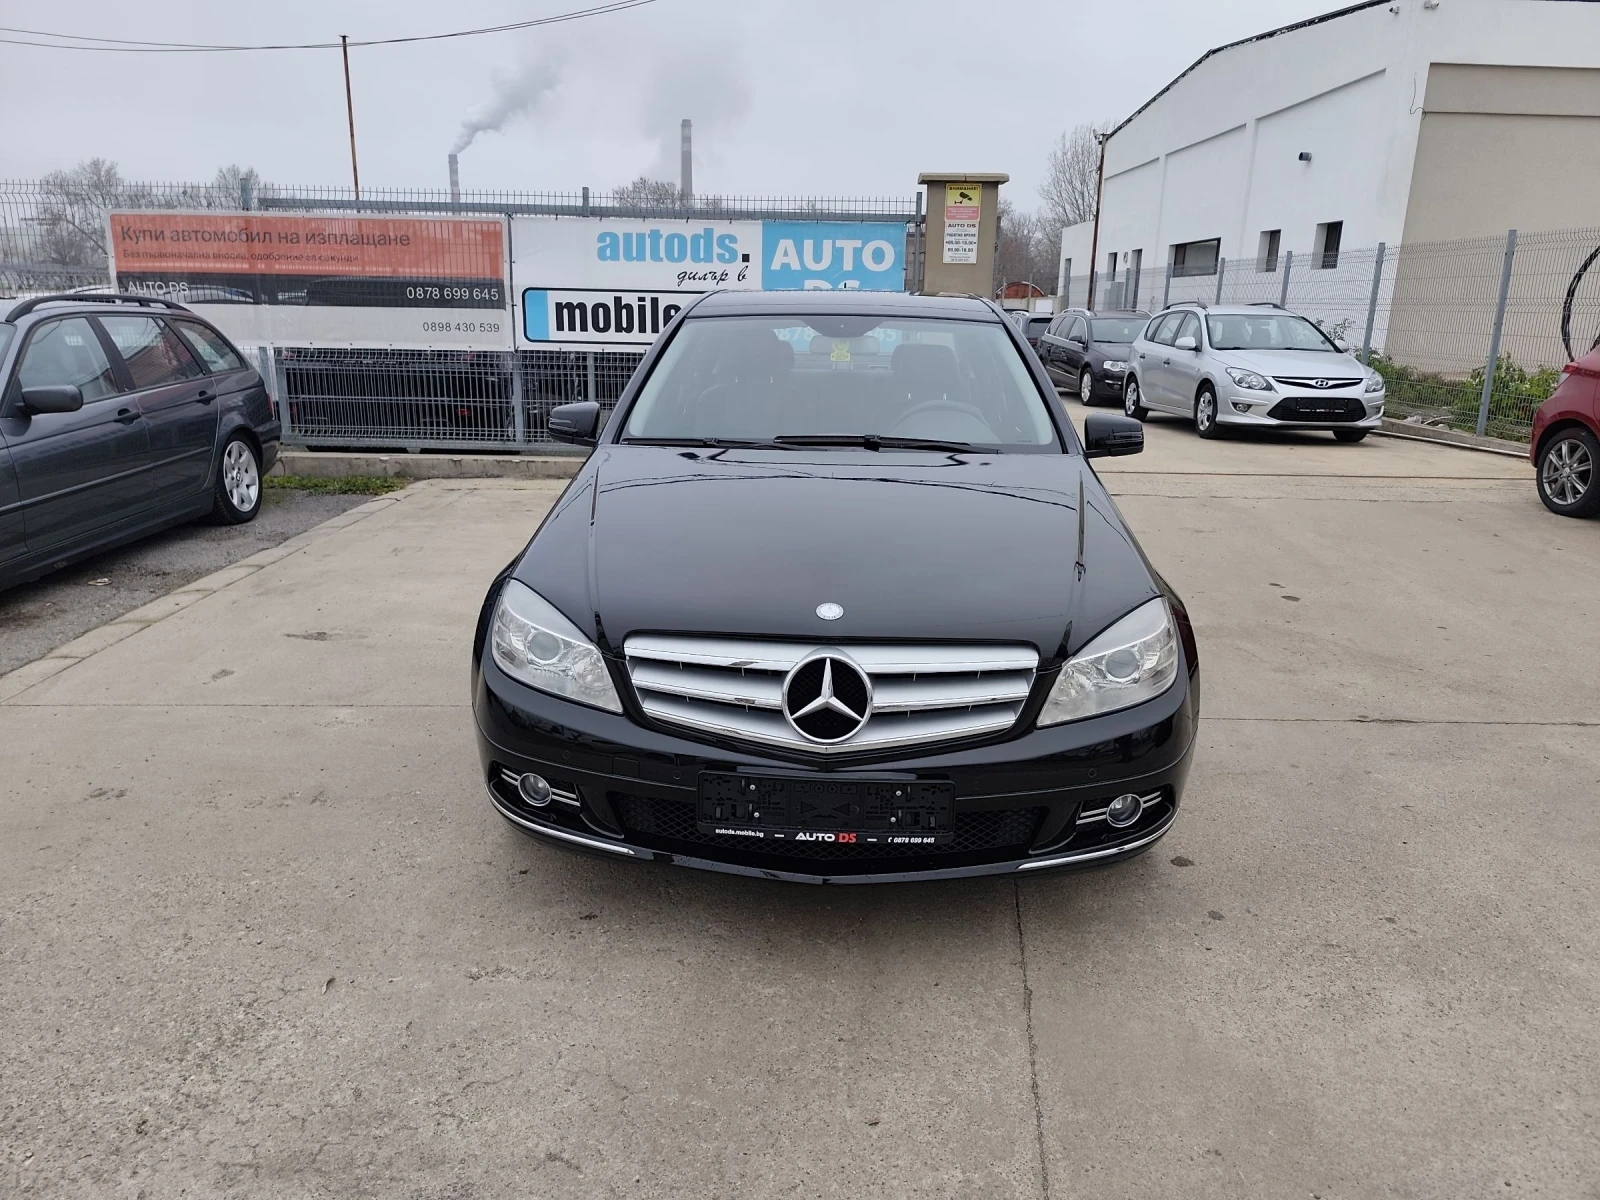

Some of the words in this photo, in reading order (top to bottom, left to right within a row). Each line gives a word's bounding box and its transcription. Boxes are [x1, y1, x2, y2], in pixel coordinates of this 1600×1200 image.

[121, 225, 164, 245] Купи
[170, 227, 273, 244] автомобил
[278, 231, 300, 244] на
[305, 231, 411, 248] изплащане
[123, 250, 141, 259] Без
[142, 251, 211, 261] първоначална
[250, 251, 304, 261] одобрение
[318, 255, 359, 263] секунди
[770, 239, 895, 272] AUTO
[676, 268, 730, 287] дилър
[737, 265, 749, 282] в
[128, 281, 166, 294] AUTO
[168, 281, 189, 294] DS
[406, 287, 440, 299] 0878
[443, 287, 469, 300] 699
[473, 288, 499, 300] 645
[422, 321, 452, 332] 0898
[454, 322, 476, 332] 430
[479, 323, 500, 333] 539
[794, 832, 836, 842] AUTO
[838, 833, 857, 843] DS
